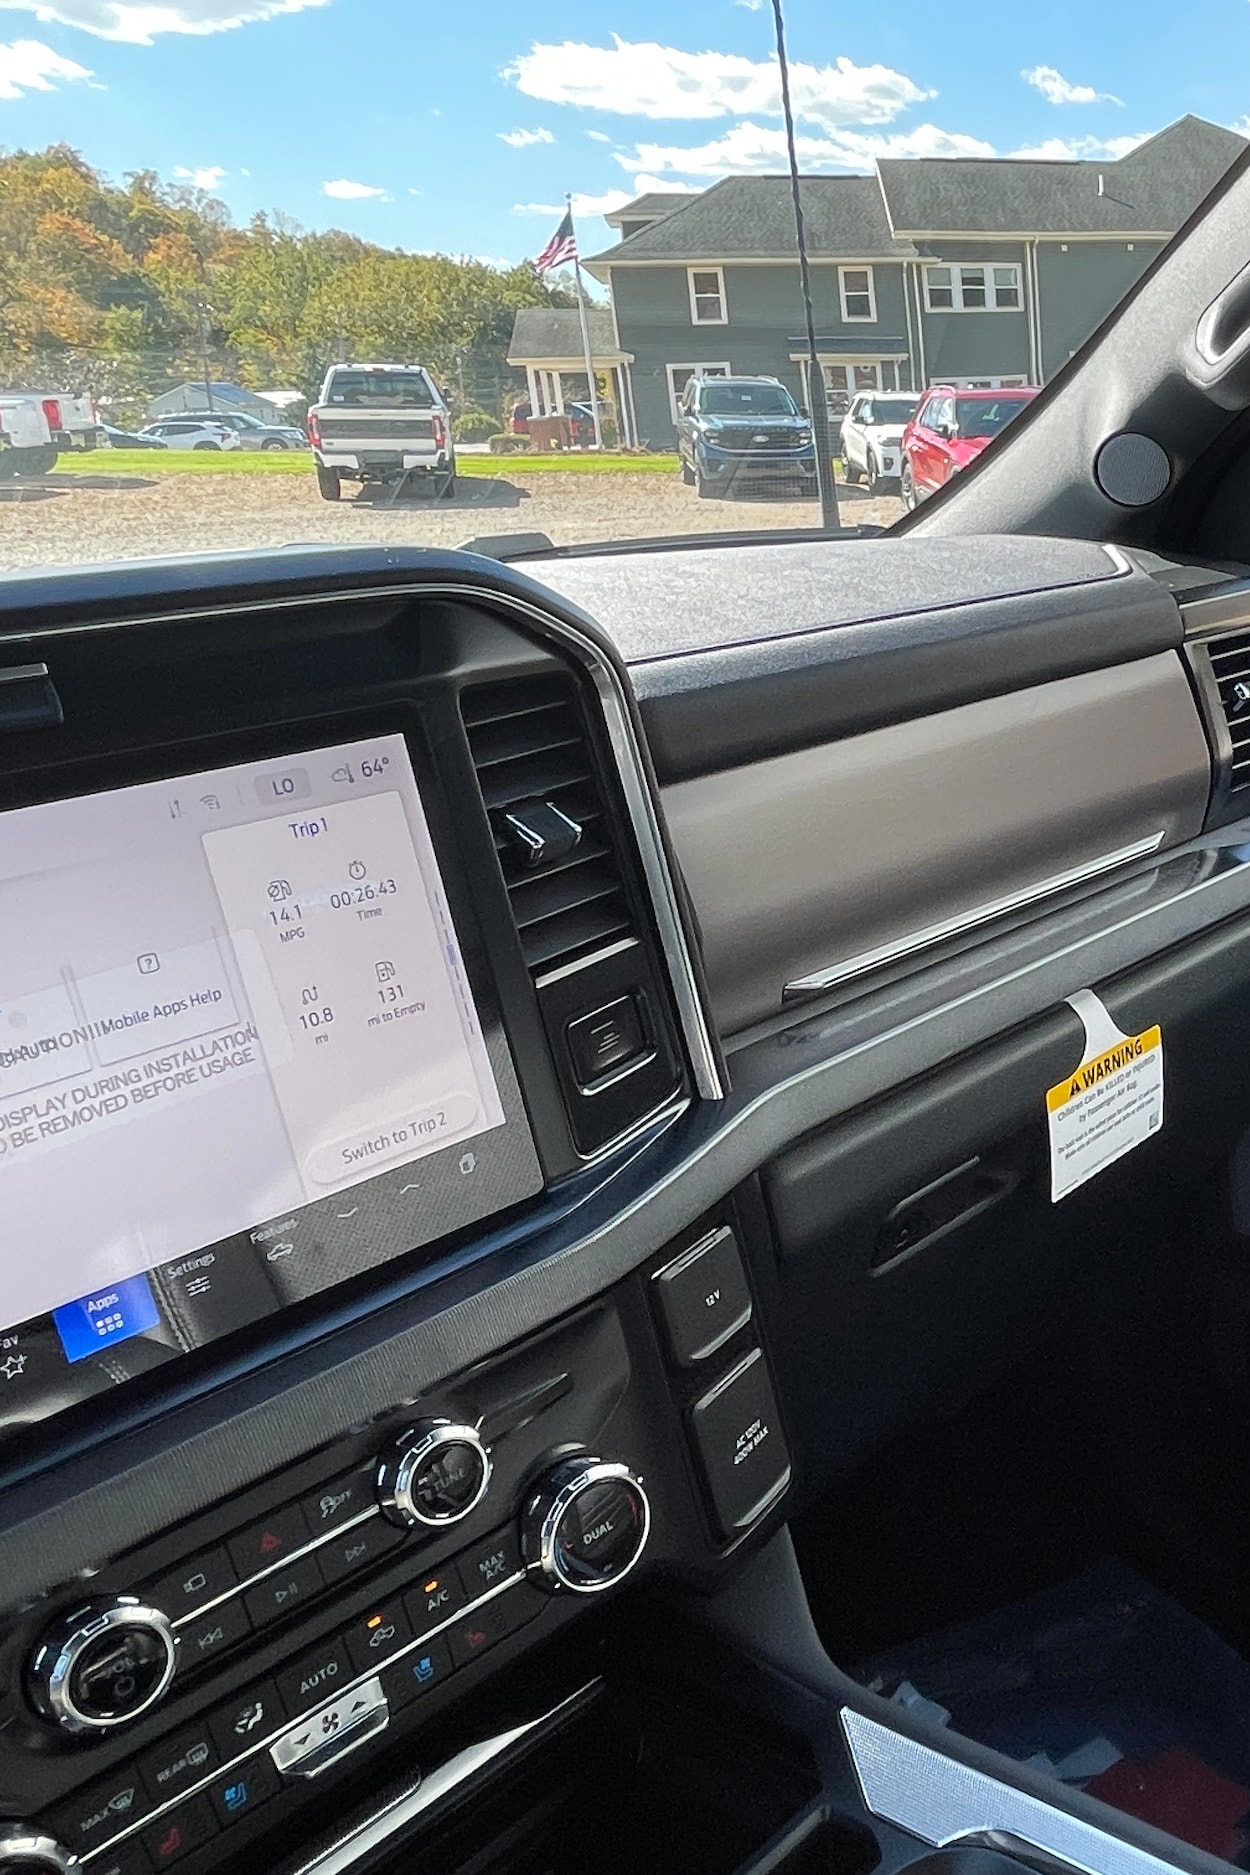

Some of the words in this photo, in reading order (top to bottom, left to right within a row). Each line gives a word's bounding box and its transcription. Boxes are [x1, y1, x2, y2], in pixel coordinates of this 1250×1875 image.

[272, 778, 295, 796] LO
[288, 821, 319, 838] Trip
[320, 818, 328, 832] 1
[330, 879, 397, 909] 00:26:43
[269, 904, 303, 926] 14.1
[356, 907, 383, 921] Time
[279, 926, 305, 944] MPG
[378, 984, 404, 1004] 131
[101, 1010, 150, 1033] Mobile
[153, 1000, 188, 1019] Apps
[189, 988, 222, 1008] Help
[299, 1007, 334, 1030] 10.8
[382, 1012, 393, 1022] to
[394, 1001, 426, 1019] Empty
[71, 1068, 142, 1105] DURING
[144, 1024, 259, 1079] INSTALLATION
[1082, 1039, 1143, 1088] WARNING
[10, 1126, 39, 1148] BE
[38, 1094, 129, 1138] REMOVED
[131, 1067, 199, 1104] BEFORE
[199, 1047, 256, 1079] USAGE
[342, 1135, 391, 1164] Switch
[392, 1130, 408, 1144] to
[409, 1118, 437, 1137] Trip
[437, 1111, 447, 1126] 2
[250, 1218, 298, 1245] Features
[167, 1252, 216, 1279] Settings
[87, 1292, 119, 1313] Apps
[705, 1289, 721, 1307] 12V
[0, 1335, 18, 1349] av
[432, 1467, 466, 1492] TUNE
[583, 1520, 614, 1546] DUAL
[478, 1551, 506, 1573] MAX
[427, 1589, 450, 1611] A/C
[300, 1661, 338, 1695] AUTO
[157, 1758, 188, 1783] REAR
[80, 1807, 111, 1833] MAX
